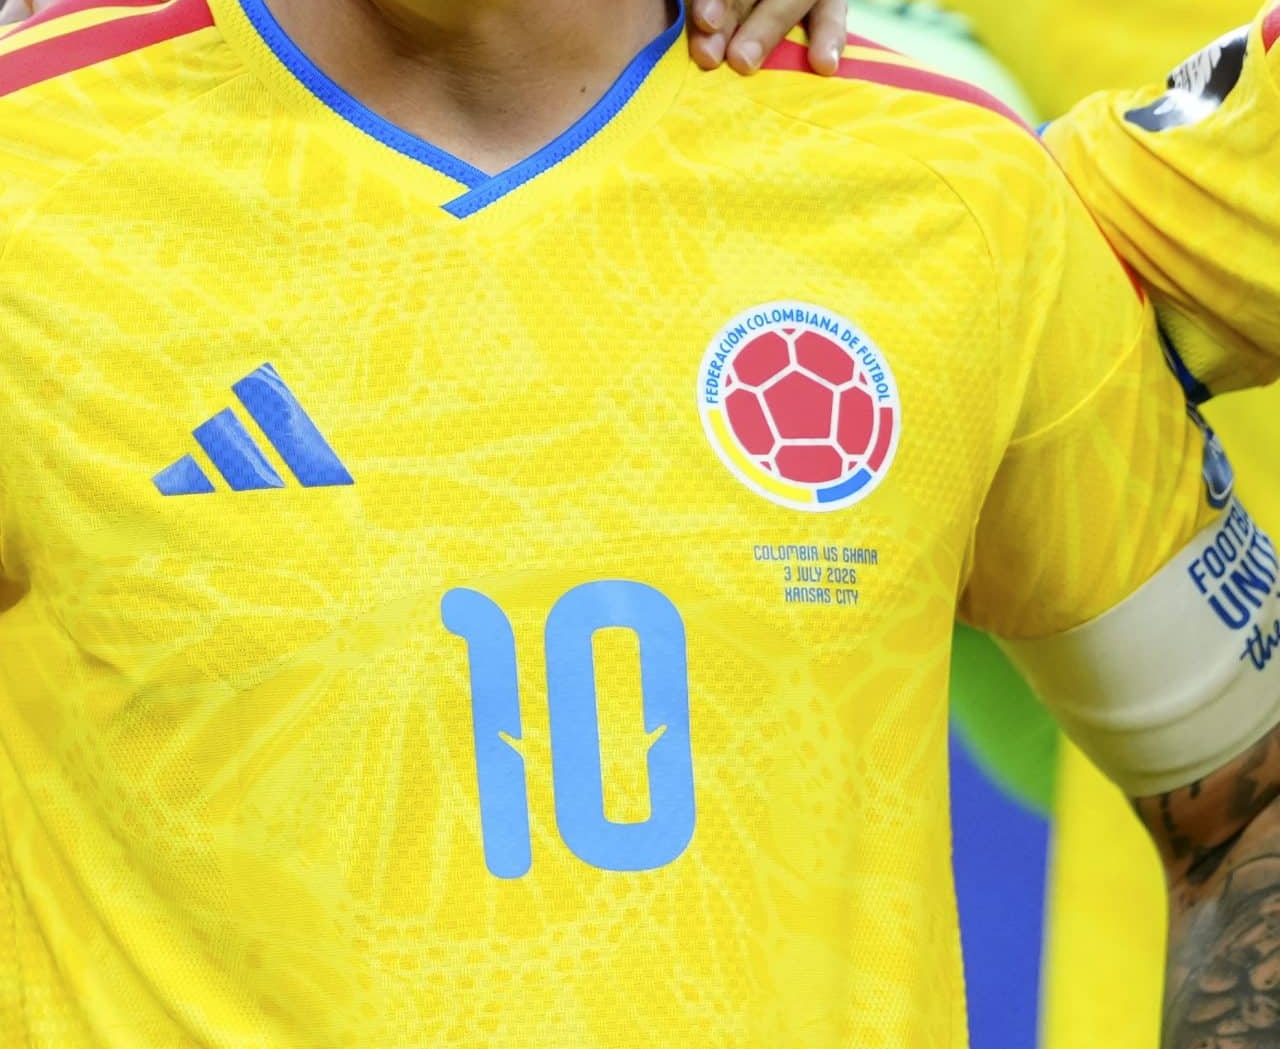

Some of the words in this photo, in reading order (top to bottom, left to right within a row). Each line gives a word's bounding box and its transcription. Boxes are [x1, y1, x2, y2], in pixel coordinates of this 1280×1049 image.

[706, 324, 747, 404] FEDERACIÓN
[747, 309, 839, 336] COLOMBIANA
[840, 329, 860, 349] DE
[856, 345, 891, 402] FÚTBOL
[753, 545, 818, 561] COLOMBIA
[843, 547, 878, 565] GHANA
[784, 566, 791, 582] 3
[796, 566, 821, 582] JULY
[827, 567, 856, 584] 2026
[1188, 504, 1253, 595] FOOTB
[1208, 529, 1279, 630] UNIT
[785, 587, 831, 604] KANSAS
[836, 588, 858, 605] CITY
[440, 579, 697, 880] 10
